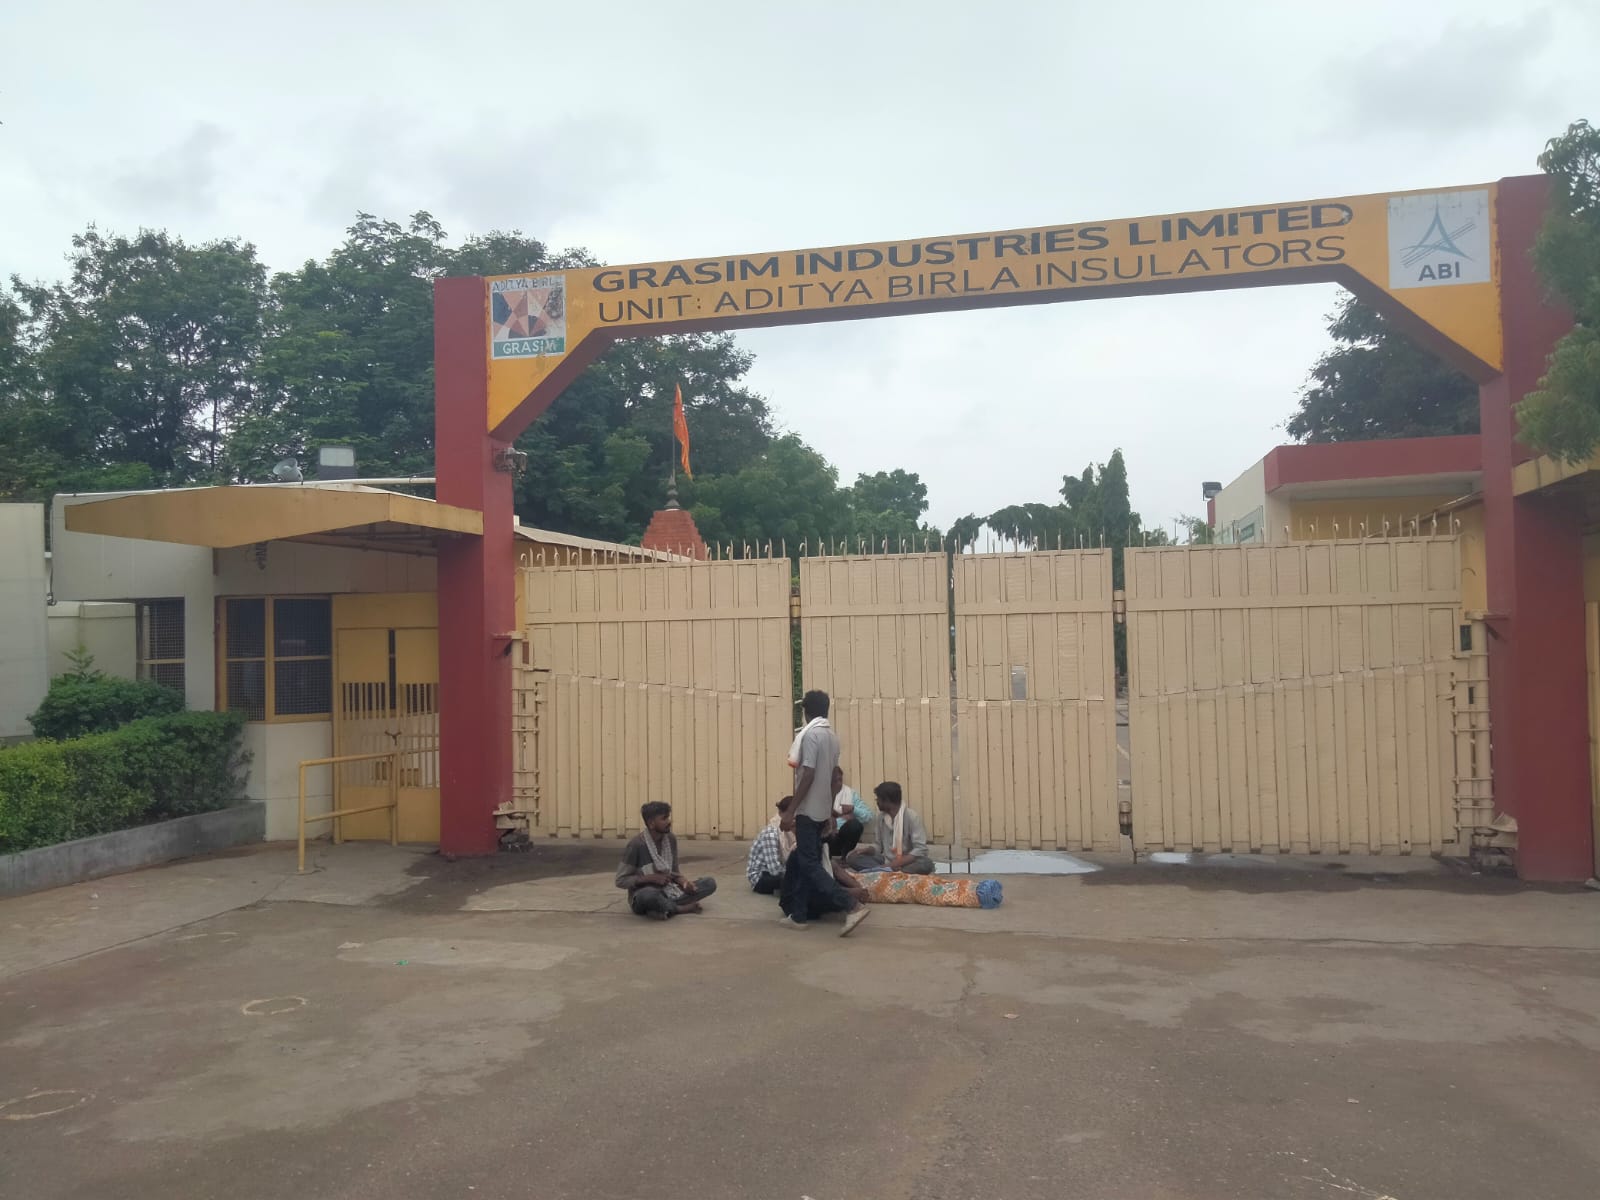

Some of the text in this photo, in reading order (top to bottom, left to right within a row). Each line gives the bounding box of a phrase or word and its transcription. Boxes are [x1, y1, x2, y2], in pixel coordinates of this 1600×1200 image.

[593, 203, 1354, 292] GRASIM INDUSTRIES LIMITED
[714, 278, 874, 313] ADITYA
[888, 266, 1021, 298] BIRLA
[1035, 236, 1346, 286] INSULATORS
[1418, 261, 1461, 281] ABI
